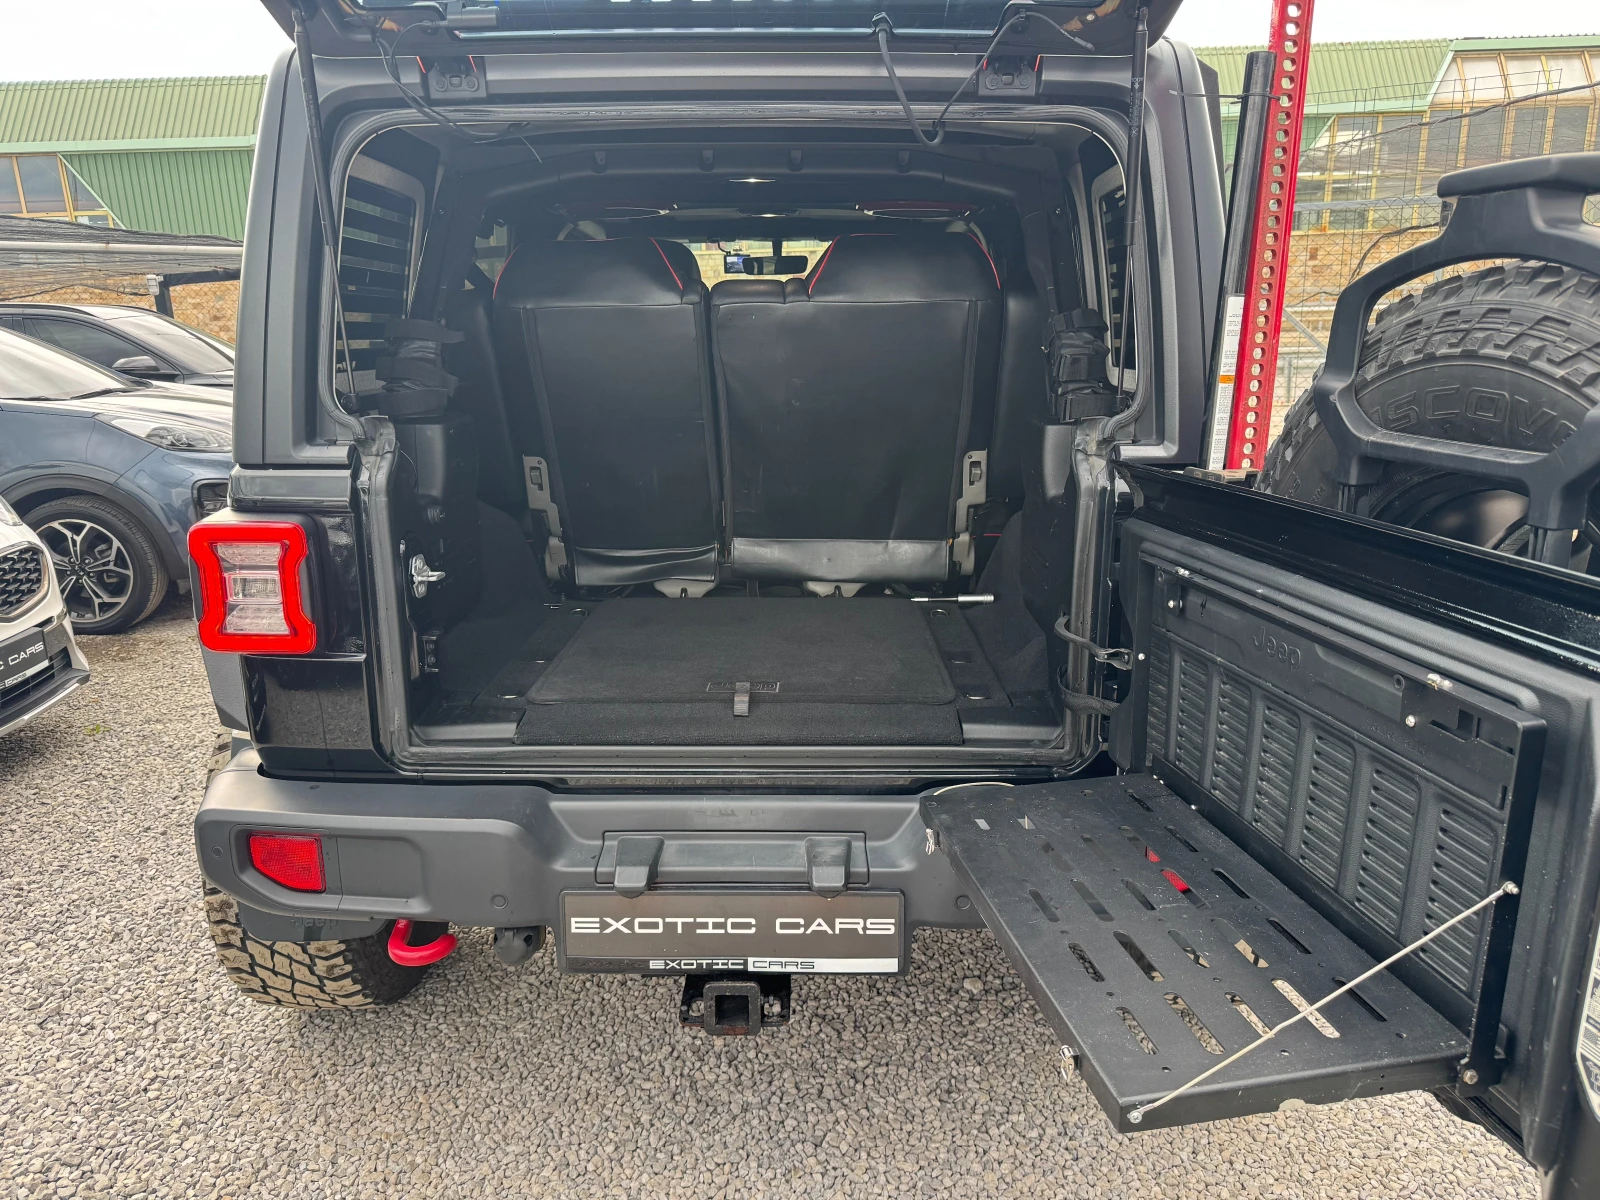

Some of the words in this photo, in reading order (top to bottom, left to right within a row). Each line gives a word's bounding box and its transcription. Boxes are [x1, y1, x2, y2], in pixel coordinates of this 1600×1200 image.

[8, 642, 44, 665] CARS
[1252, 625, 1301, 673] Jeep
[570, 917, 756, 934] EXOTIC
[775, 918, 896, 935] CARS
[649, 960, 744, 969] EXOTIC
[752, 960, 815, 969] CARS
